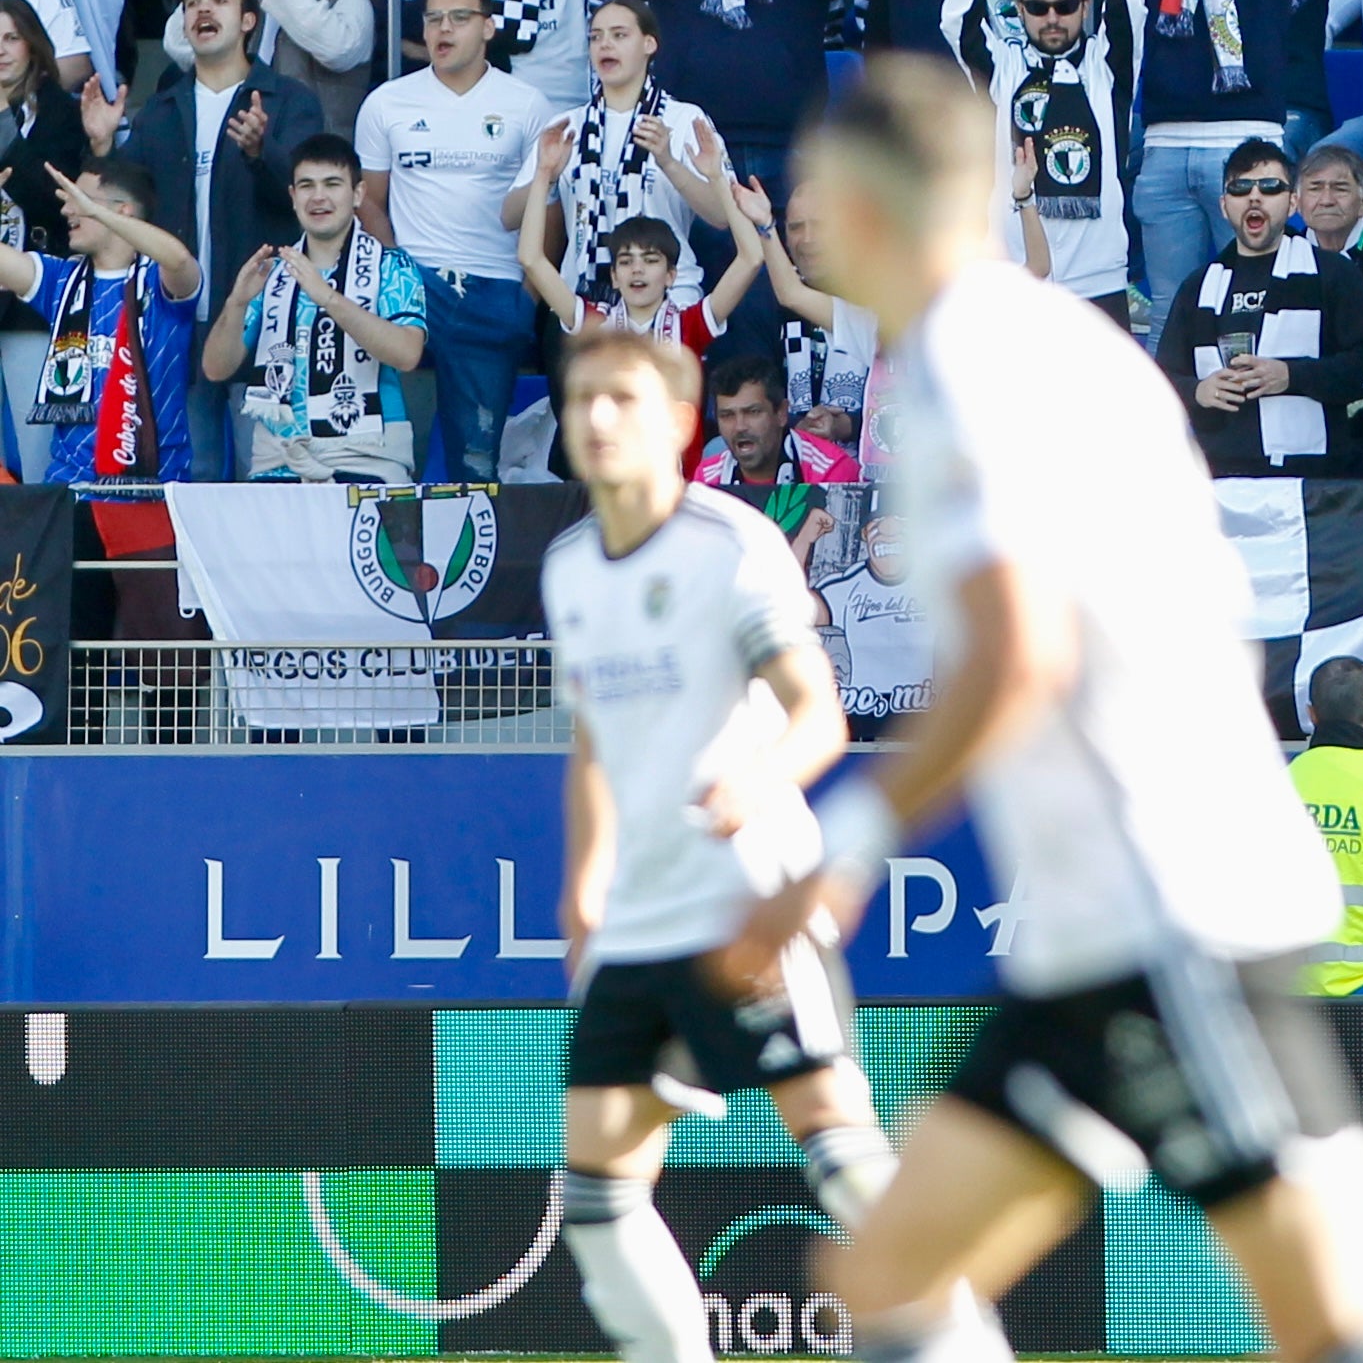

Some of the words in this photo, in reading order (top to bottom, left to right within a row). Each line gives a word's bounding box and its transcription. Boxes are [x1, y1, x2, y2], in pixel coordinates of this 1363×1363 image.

[112, 398, 143, 466] Cabeza
[354, 511, 395, 605] BURGOS
[459, 508, 493, 595] FUTBOL
[359, 646, 458, 675] CLUB
[1303, 802, 1361, 830] RDA
